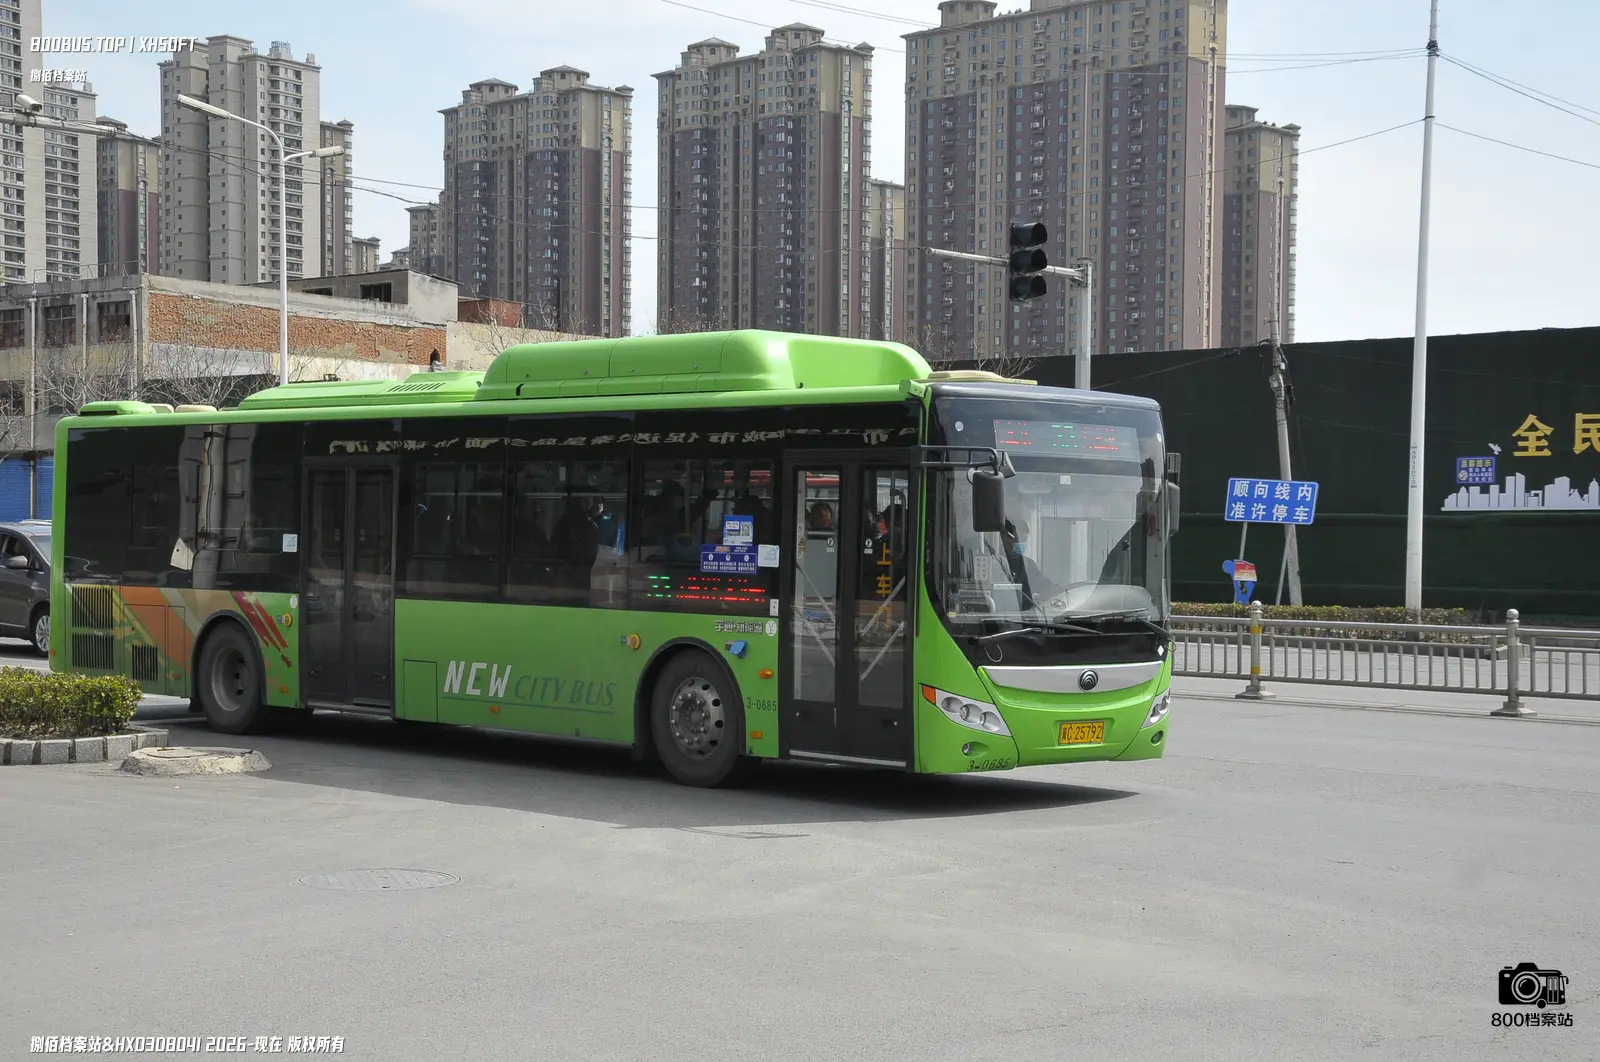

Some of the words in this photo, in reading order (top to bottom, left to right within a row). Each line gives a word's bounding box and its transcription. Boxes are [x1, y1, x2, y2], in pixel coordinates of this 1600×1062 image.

[1233, 480, 1313, 501] 顺向线内
[1230, 501, 1310, 522] 准许停车
[443, 660, 512, 698] NEW
[514, 675, 567, 703] CITY
[568, 678, 617, 707] BUS
[746, 696, 777, 712] 3-0685
[967, 757, 1011, 772] 3-0685
